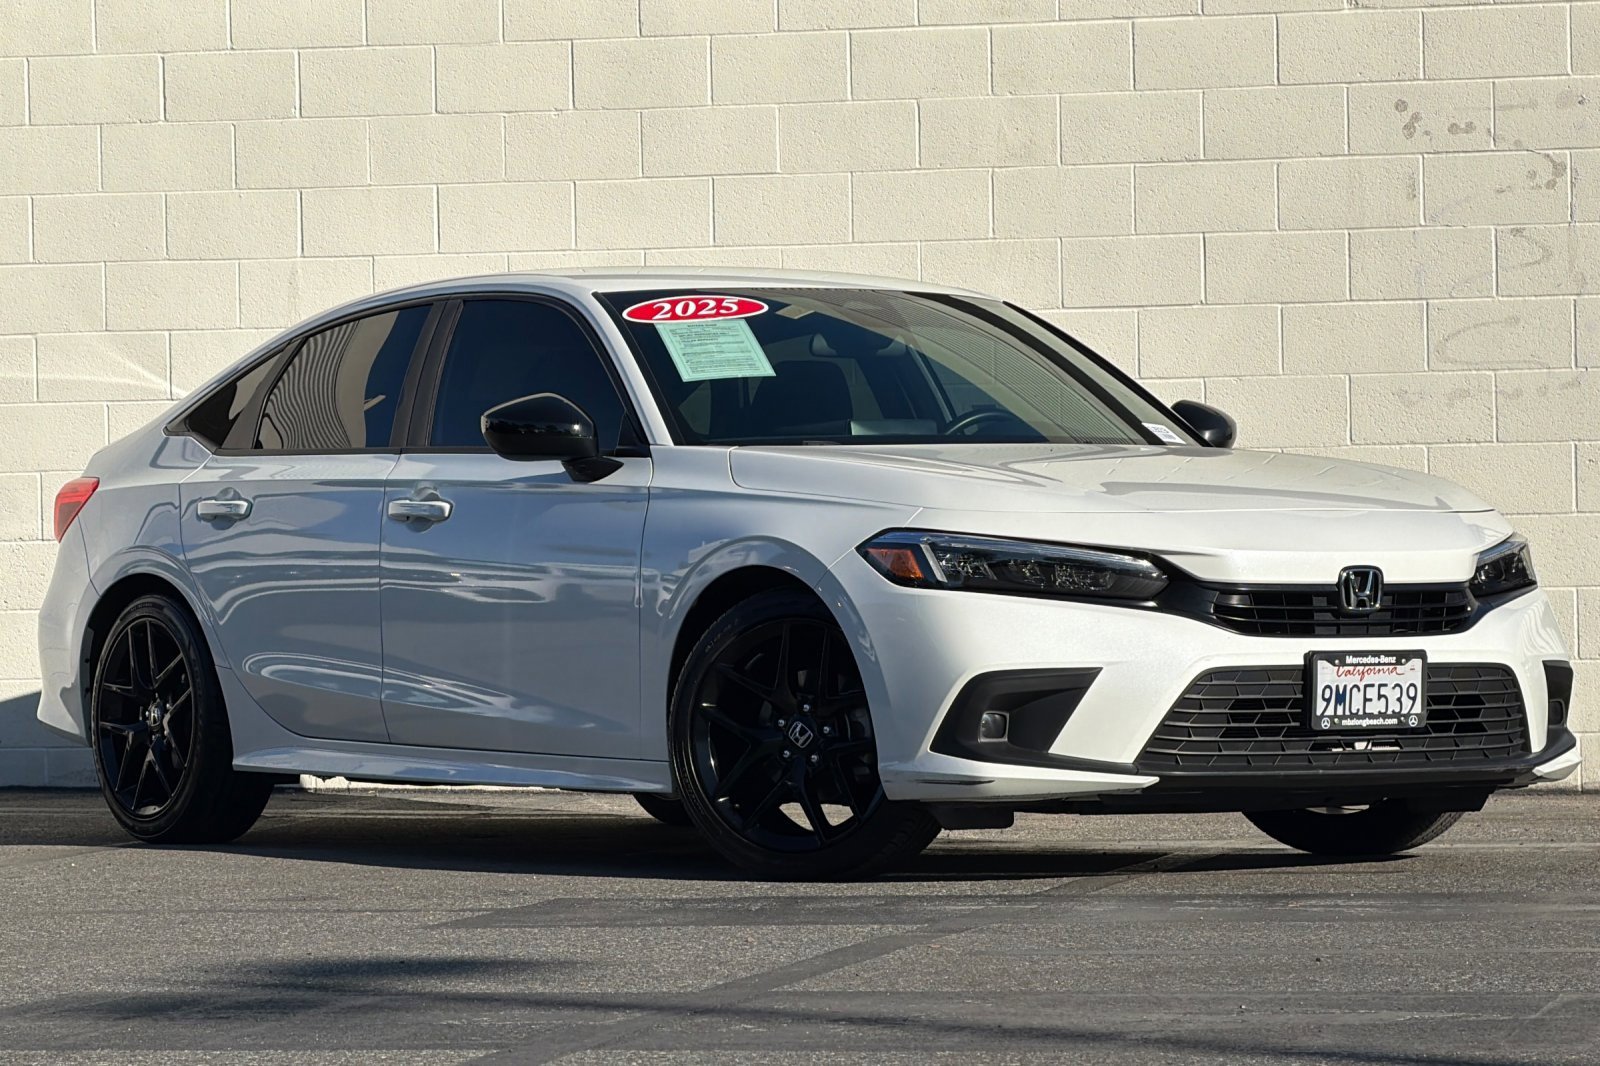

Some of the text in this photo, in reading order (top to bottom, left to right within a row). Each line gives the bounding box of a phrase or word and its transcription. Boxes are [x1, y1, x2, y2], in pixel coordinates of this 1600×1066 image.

[652, 298, 739, 320] 2025
[1346, 655, 1396, 664] Mercedes-Benz
[1336, 666, 1405, 681] California
[1320, 683, 1418, 716] 9MCE539
